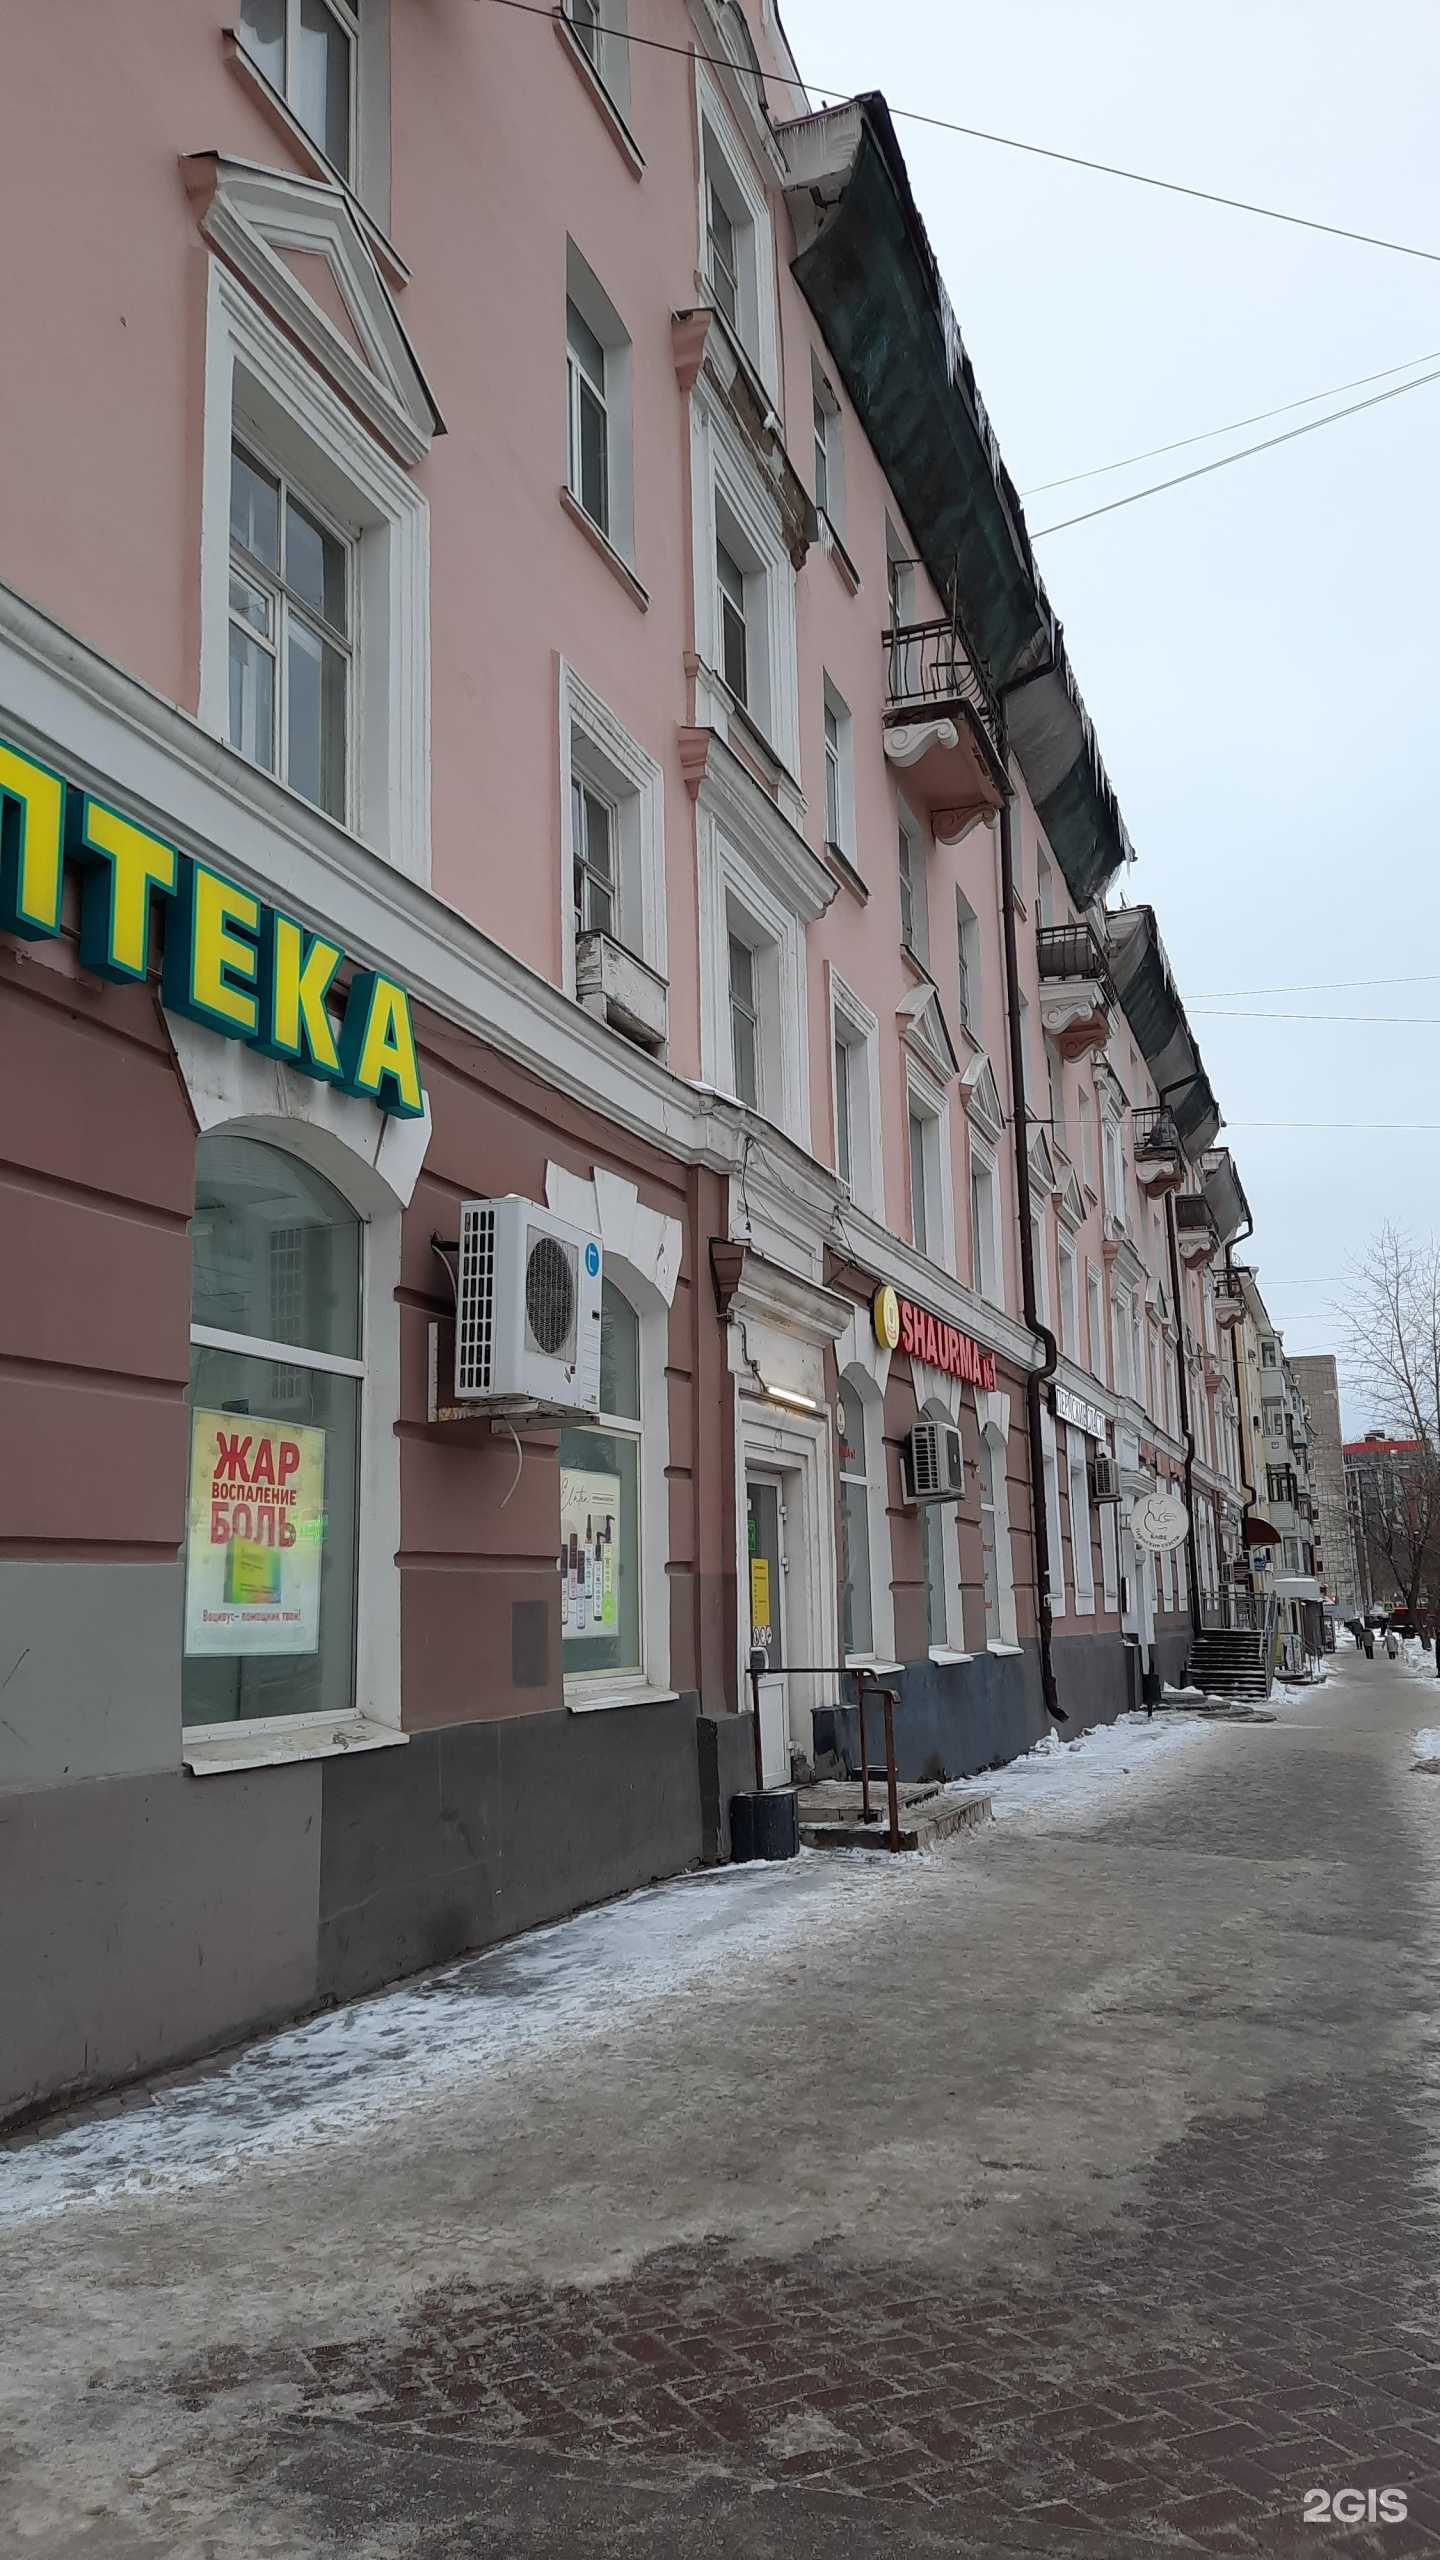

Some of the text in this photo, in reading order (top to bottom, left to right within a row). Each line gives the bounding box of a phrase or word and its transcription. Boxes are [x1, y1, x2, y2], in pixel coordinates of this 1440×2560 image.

[900, 1300, 983, 1386] SHAURMA
[213, 1431, 300, 1486] ЖАР
[211, 1482, 297, 1506] ВОСПАЛЕНИЕ
[210, 1501, 297, 1548] БОЛЬ
